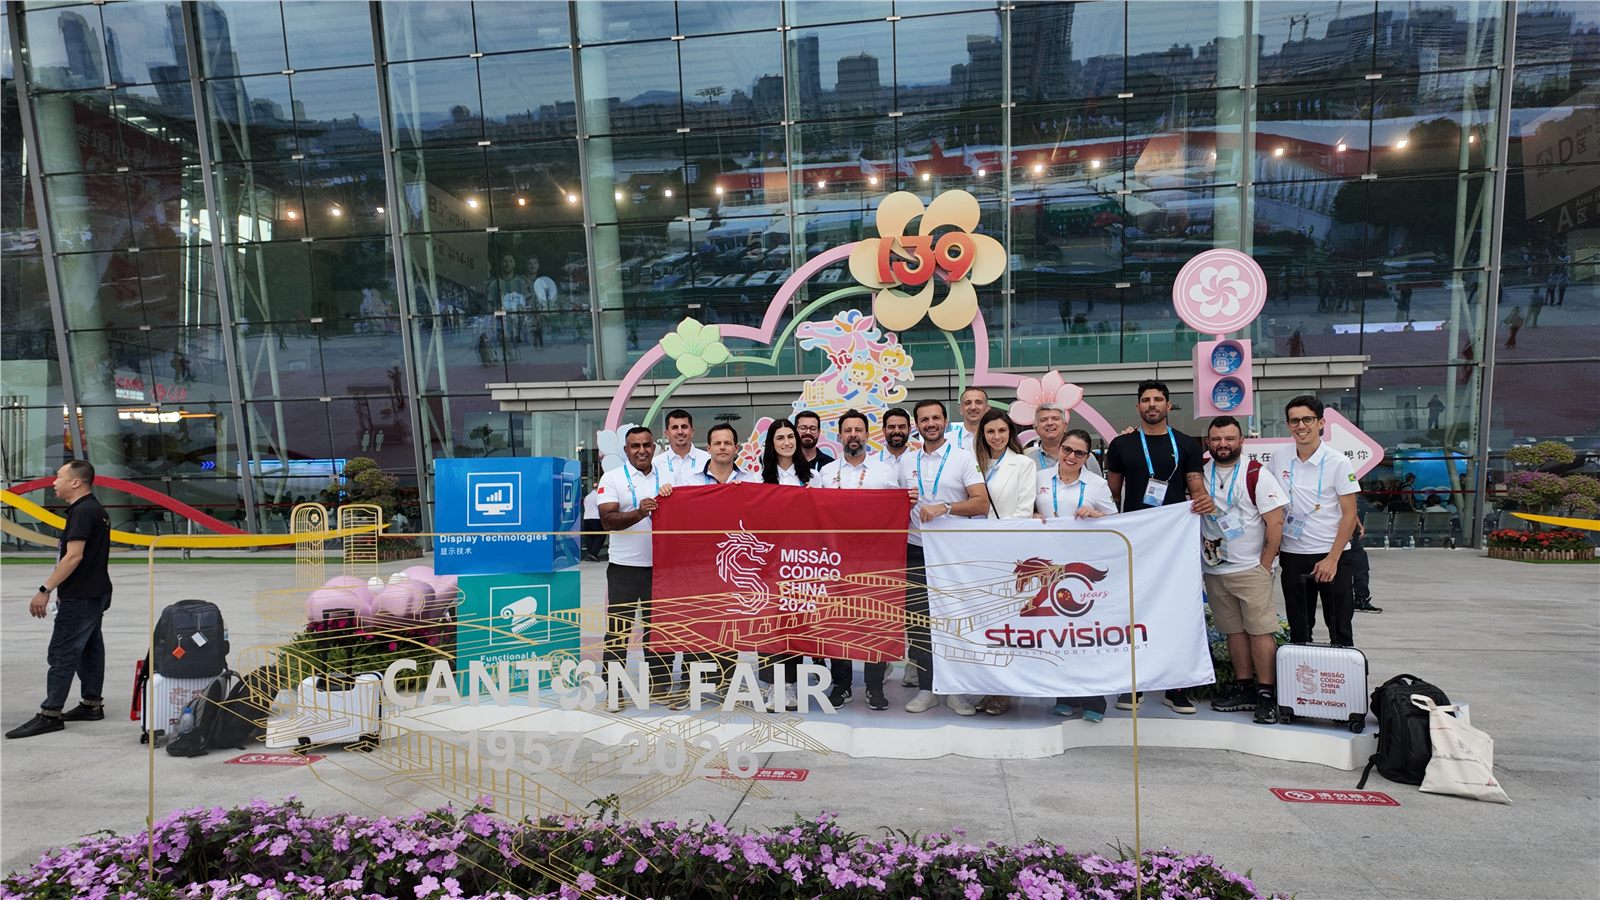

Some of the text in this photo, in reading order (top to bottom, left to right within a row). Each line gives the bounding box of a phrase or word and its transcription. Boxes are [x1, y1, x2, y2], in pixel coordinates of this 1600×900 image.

[878, 231, 976, 286] 139
[440, 534, 478, 544] Display
[481, 533, 548, 543] Technologies
[440, 547, 473, 556] 显示技术
[780, 547, 842, 566] MISSÃO
[779, 563, 841, 582] CÓDIGO
[780, 582, 829, 598] CHINA
[1080, 589, 1110, 602] years
[779, 598, 817, 613] 2026
[984, 621, 1148, 649] starvision
[480, 651, 530, 662] Functional
[689, 661, 838, 715] FAIR
